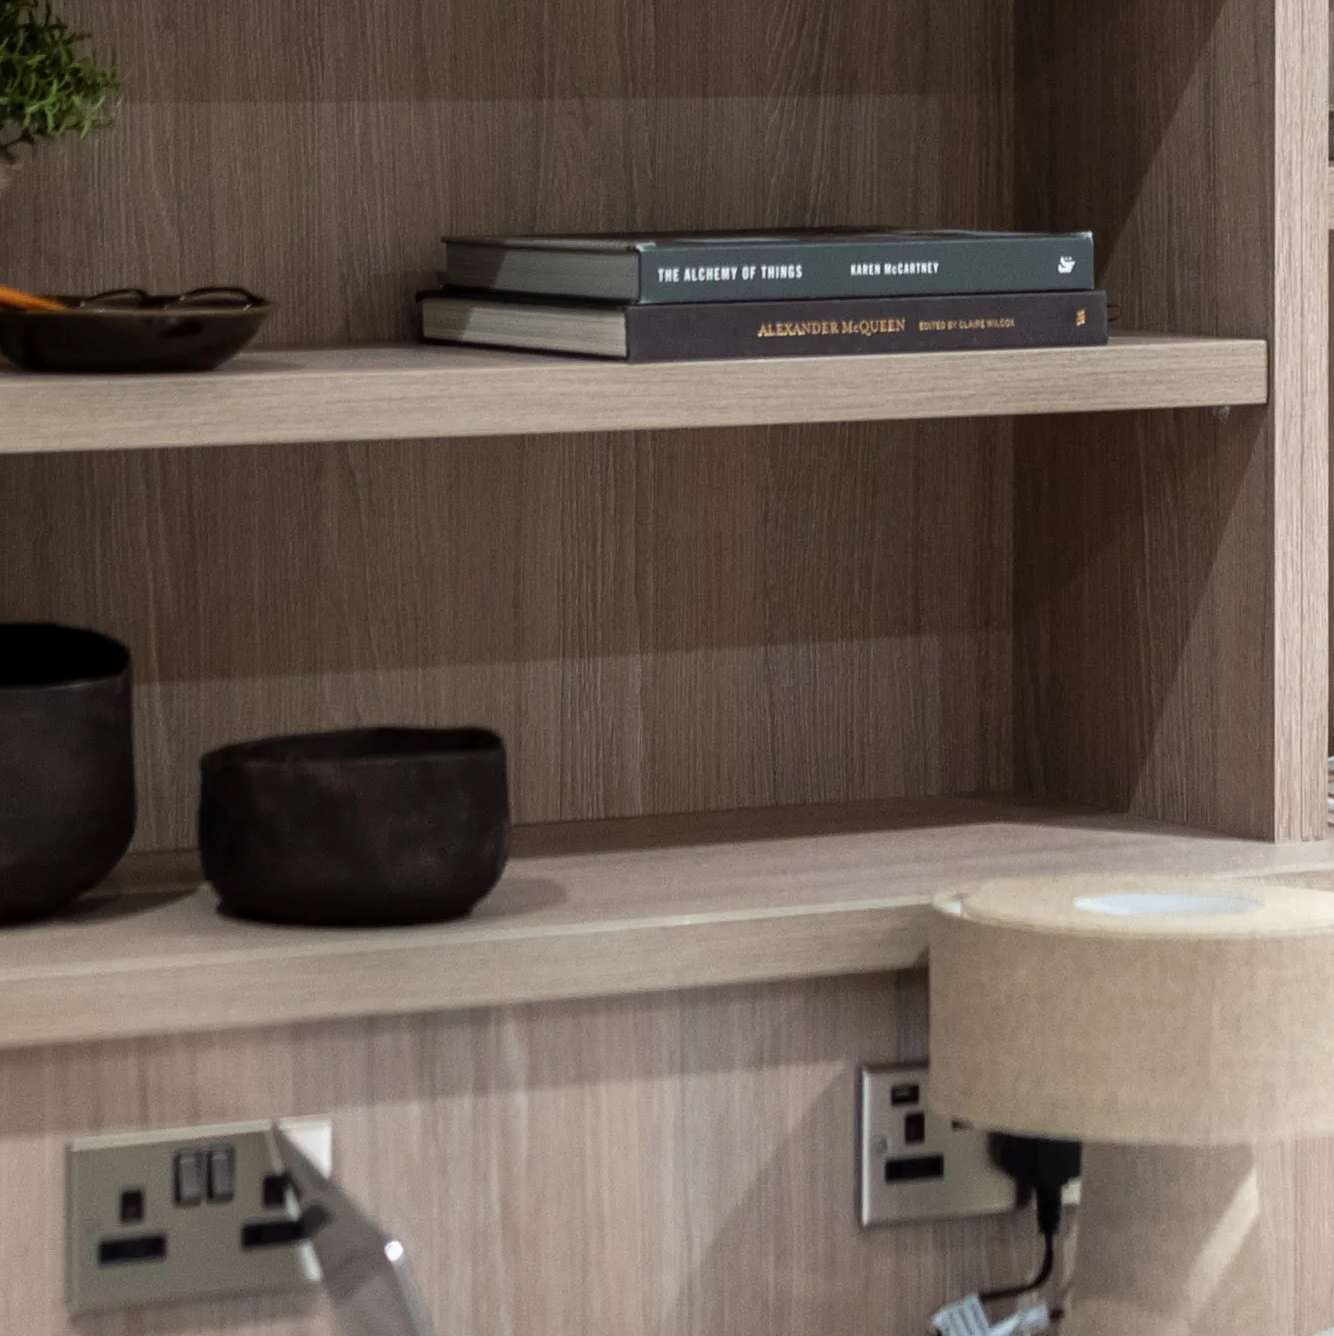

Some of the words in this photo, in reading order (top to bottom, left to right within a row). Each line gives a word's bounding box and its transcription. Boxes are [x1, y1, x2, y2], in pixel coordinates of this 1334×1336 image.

[657, 268, 680, 284] THE
[683, 266, 738, 283] ALCHEMY
[741, 266, 756, 281] OF
[761, 264, 803, 280] THINGS
[850, 263, 882, 277] KAREN
[883, 261, 940, 276] McCARTNEY
[757, 320, 840, 338] ALEXANDER
[841, 318, 907, 337] McQUEEN
[918, 320, 947, 331] EDITED
[947, 319, 959, 331] BY
[958, 318, 986, 331] CLAIRE
[986, 317, 1016, 329] WILCOX
